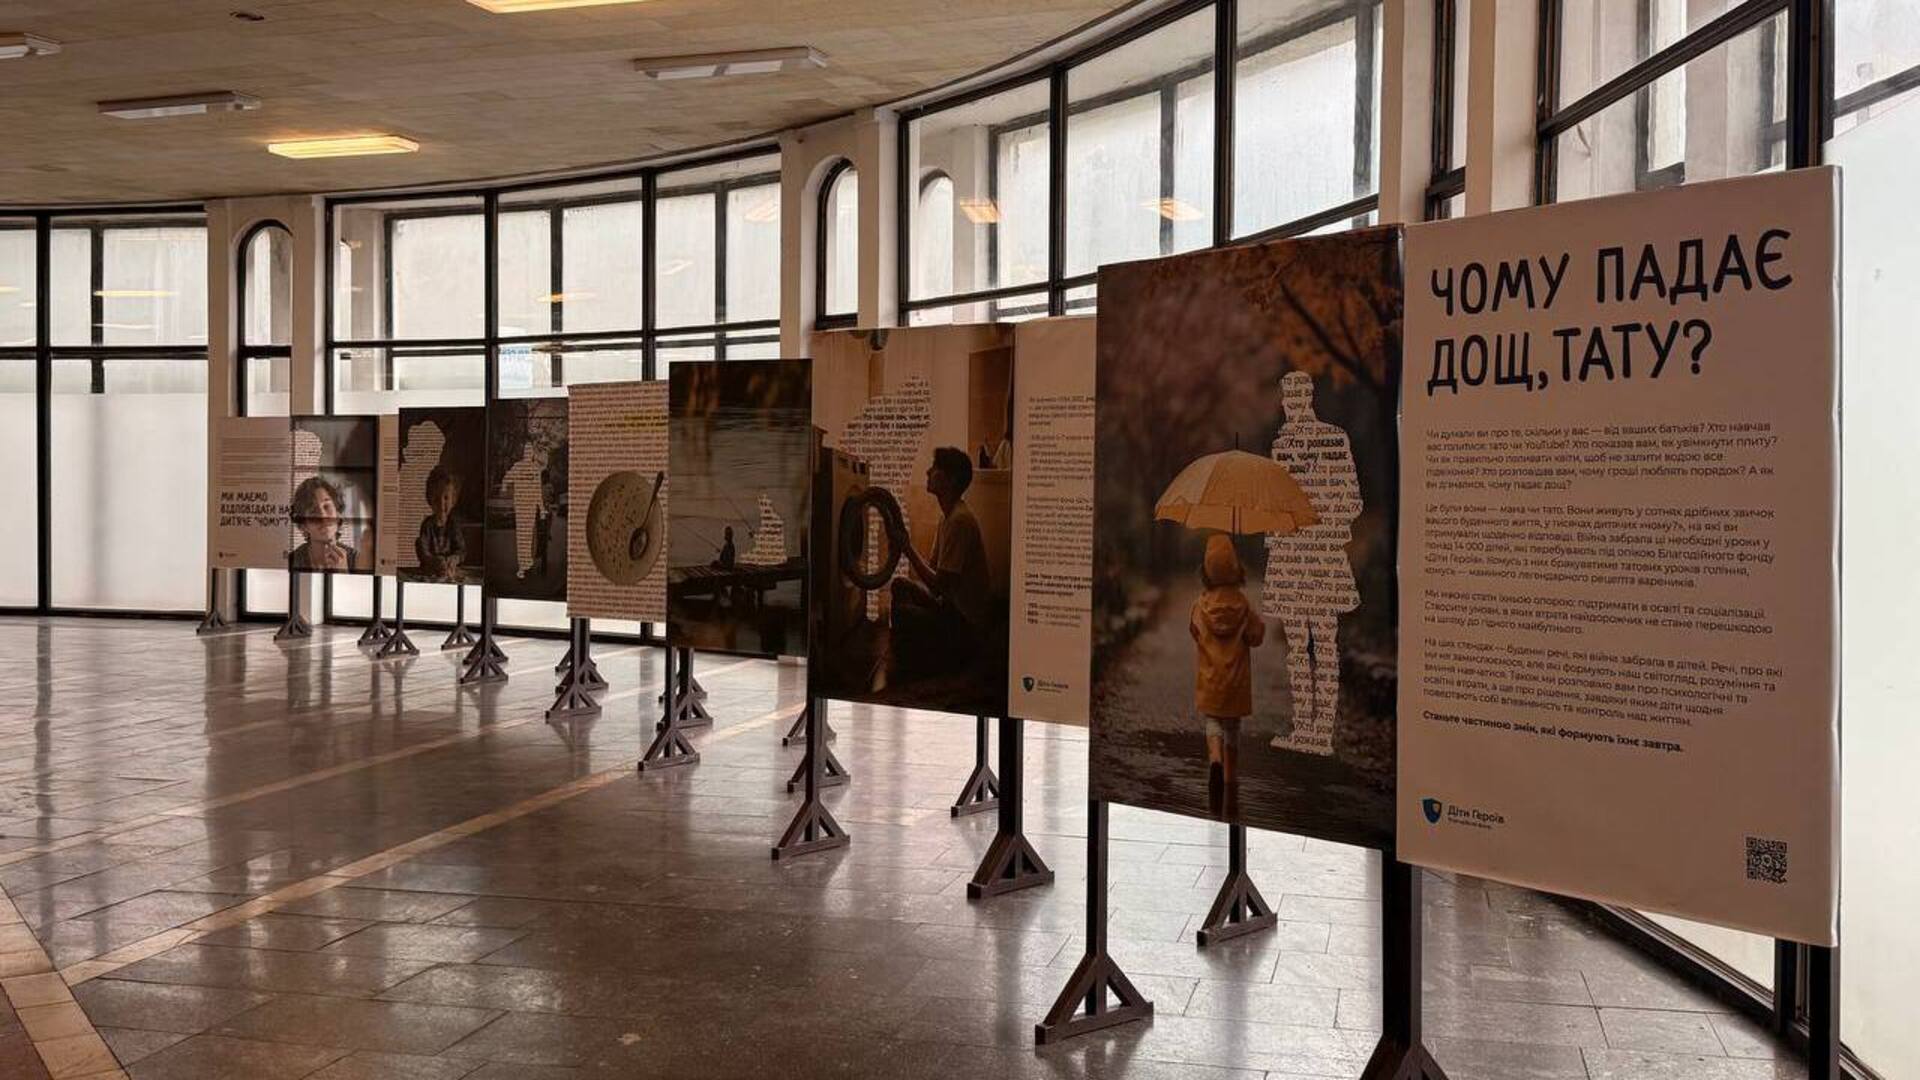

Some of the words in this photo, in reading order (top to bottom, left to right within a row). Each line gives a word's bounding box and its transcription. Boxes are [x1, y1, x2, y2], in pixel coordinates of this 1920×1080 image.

[1431, 253, 1570, 316] ЧОМУ
[1597, 228, 1793, 305] ПАДАЄ
[1489, 429, 1507, 439] про
[1571, 427, 1588, 435] вас
[1604, 424, 1619, 435] від
[1659, 422, 1705, 433] батьків?
[1707, 421, 1726, 432] Хто
[1729, 422, 1770, 431] навчав
[1523, 439, 1569, 449] YouTube?
[1572, 439, 1589, 448] Хто
[1676, 436, 1732, 449] увімкнути
[1736, 435, 1777, 448] плиту?
[1664, 453, 1700, 463] водою
[1690, 464, 1745, 477] порядок?
[1544, 479, 1571, 490] дощ?
[1567, 504, 1593, 514] Вони
[1596, 507, 1633, 517] живуть
[1684, 506, 1729, 518] дрібних
[1732, 509, 1774, 517] звичок
[1609, 532, 1652, 545] забрала
[1668, 534, 1721, 546] необхідні
[1724, 537, 1759, 548] уроки
[1465, 541, 1483, 551] 000
[1657, 547, 1734, 560] Благодійного
[1736, 550, 1773, 564] фонду
[1664, 562, 1699, 574] уроків
[1578, 597, 1638, 611] підтримати
[1650, 602, 1680, 613] освіті
[1518, 620, 1582, 634] майбутнього.
[1695, 621, 1772, 634] перешкодою
[1622, 654, 1664, 667] забрала
[1676, 658, 1707, 670] дітей.
[1740, 665, 1763, 677] про
[1766, 666, 1782, 677] які
[1562, 661, 1615, 676] формують
[1700, 676, 1760, 690] розуміння
[1637, 684, 1657, 696] про
[1661, 687, 1733, 702] психологічні
[1659, 699, 1682, 711] діти
[1685, 703, 1723, 715] щодня
[1461, 716, 1510, 730] частиною
[1513, 721, 1538, 735] змін,
[1540, 725, 1555, 736] які
[1558, 726, 1614, 743] формують
[1617, 733, 1638, 746] їхнє
[1642, 739, 1682, 753] завтра.
[1448, 804, 1469, 816] Діти
[1472, 807, 1505, 824] Героїв
